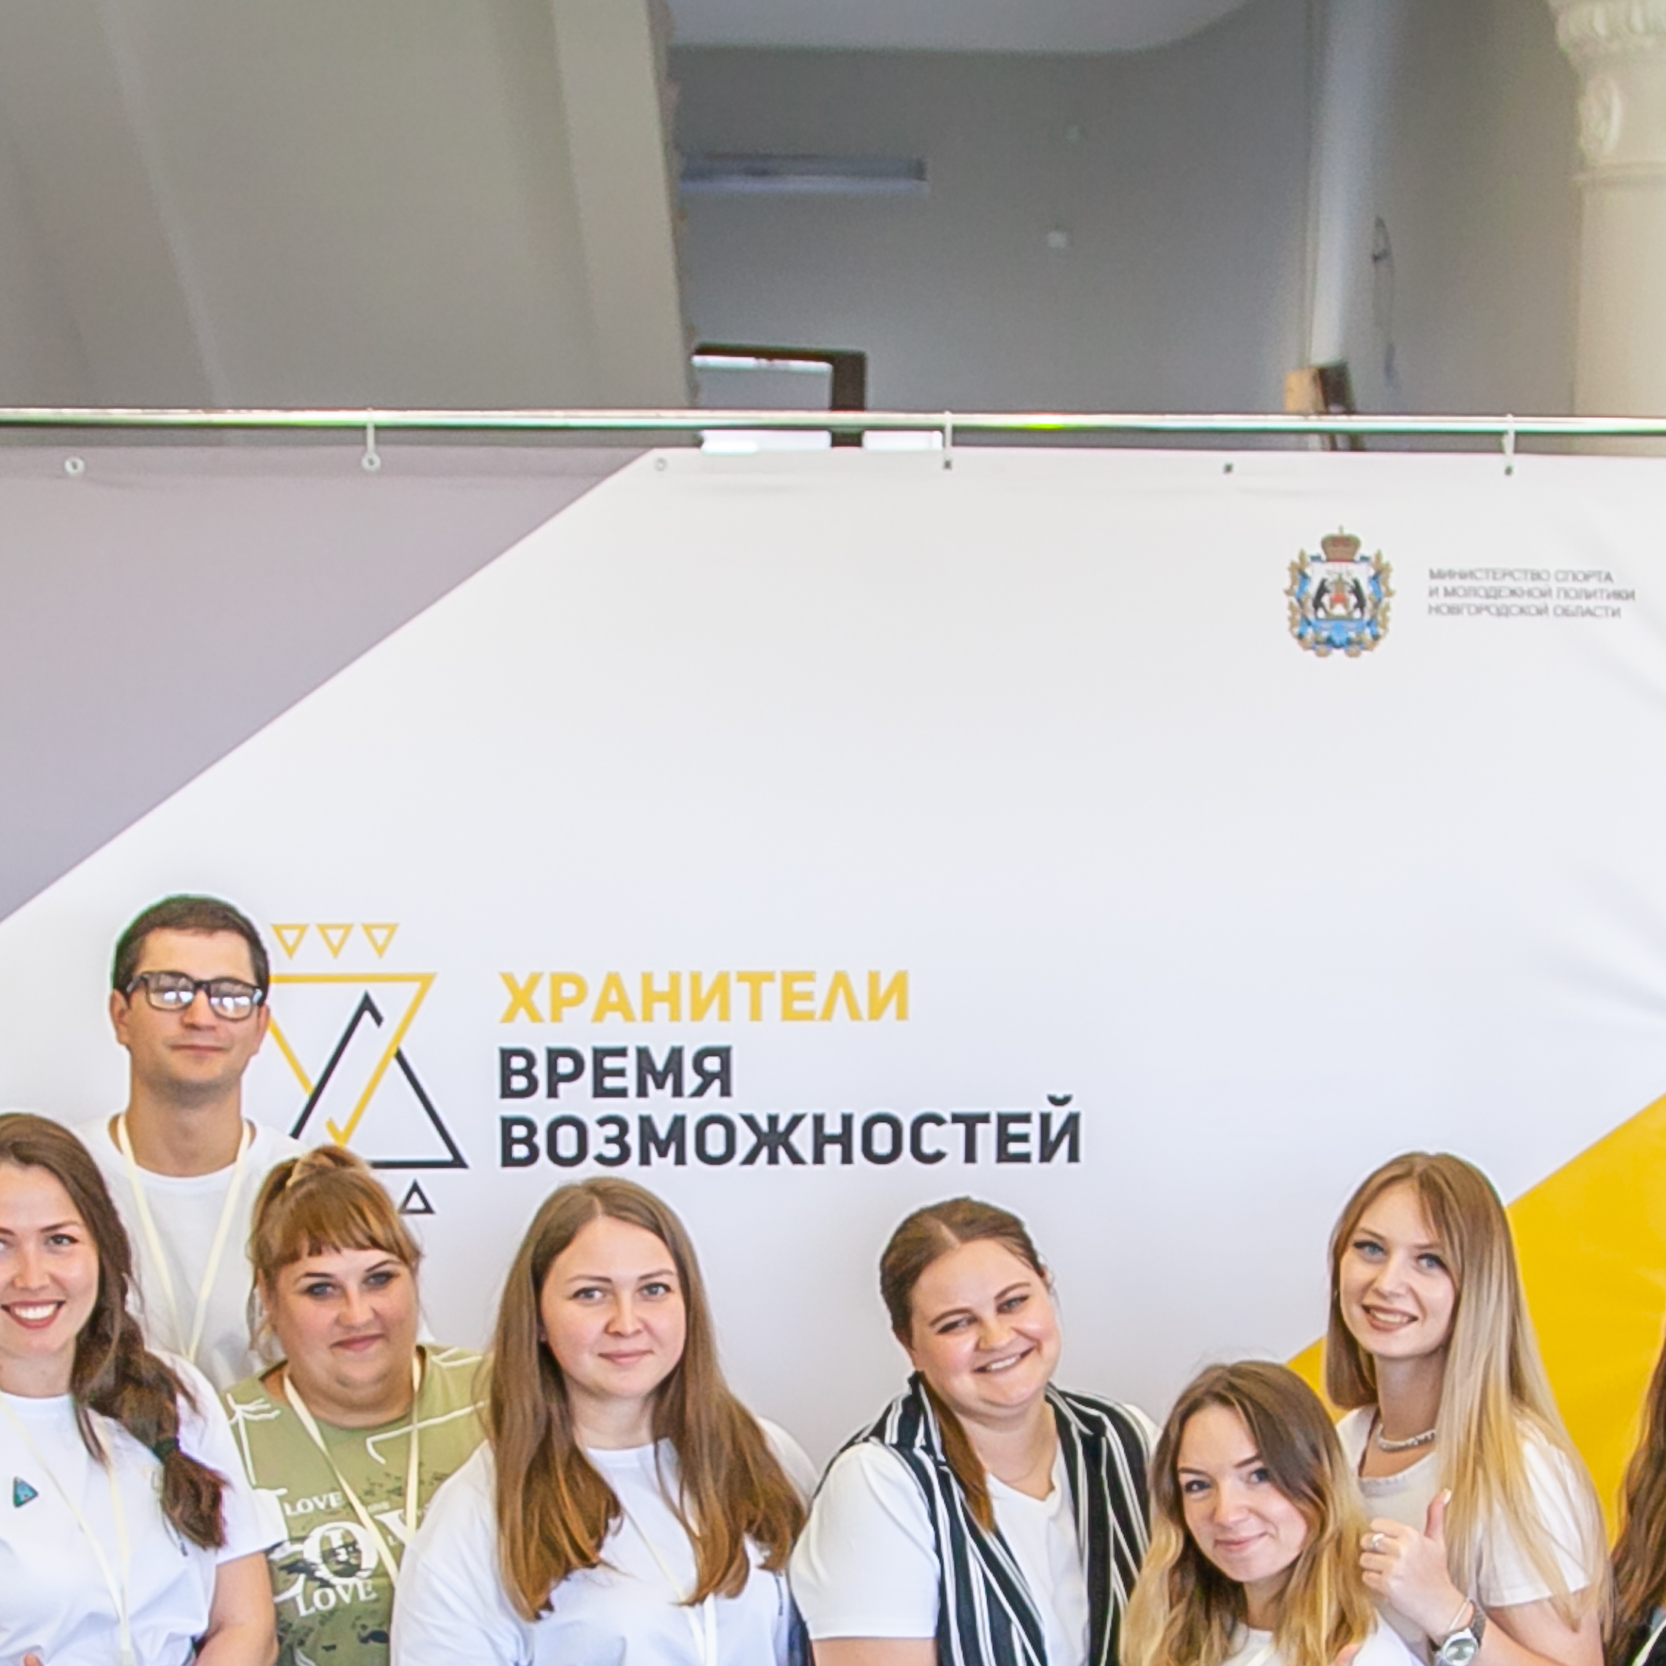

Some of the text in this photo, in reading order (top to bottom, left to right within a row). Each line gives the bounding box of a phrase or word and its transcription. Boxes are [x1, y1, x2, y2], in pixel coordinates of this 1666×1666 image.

[1429, 568, 1614, 583] МИНИСТЕРСТВО СПОРТА
[1429, 586, 1439, 598] И
[1556, 588, 1635, 601] ПОЛИТИКИ
[1428, 603, 1621, 618] НОВГОРОДСКОЙ ОБЛАСТИ
[499, 970, 910, 1024] ХРАНИТЕЛИ
[499, 1045, 733, 1099] ВРЕМЯ
[499, 1095, 1082, 1169] ВОЗМОЖНОСТЕЙ
[284, 1491, 344, 1516] LOVE
[295, 1580, 378, 1617] LOVE
